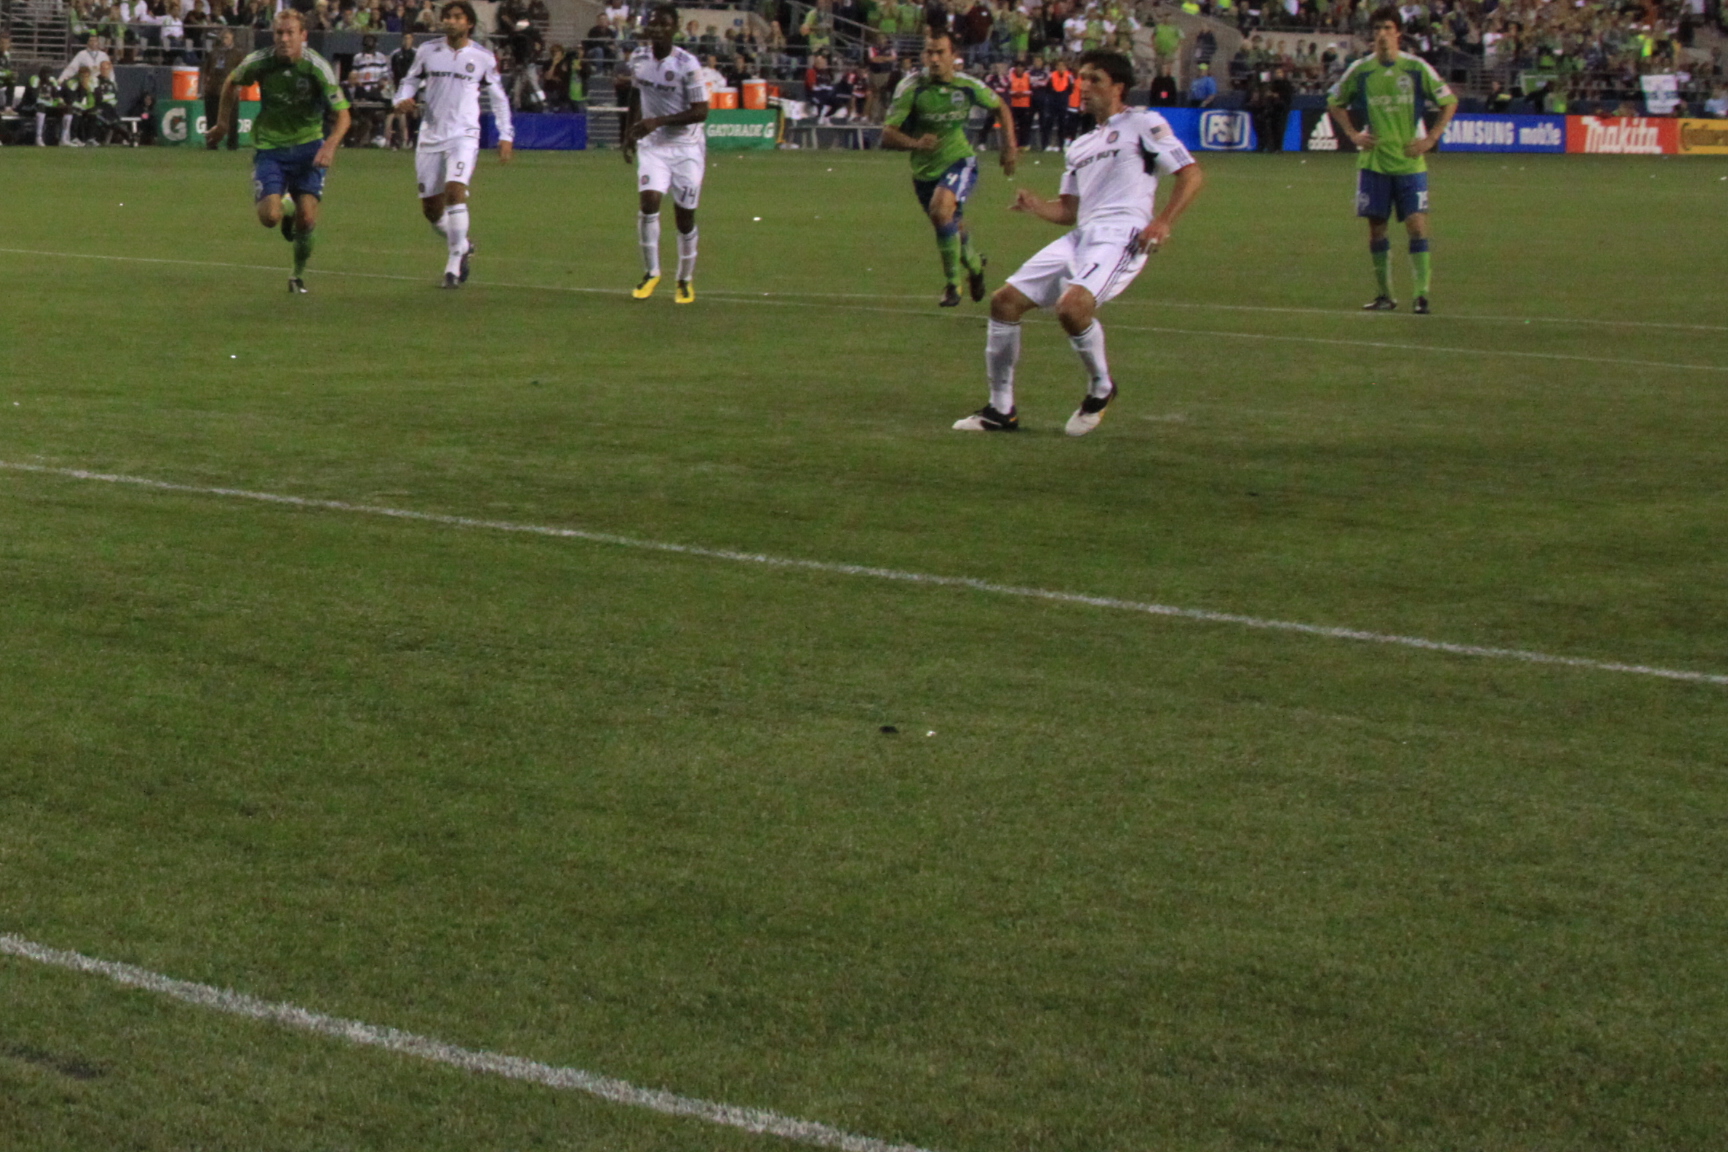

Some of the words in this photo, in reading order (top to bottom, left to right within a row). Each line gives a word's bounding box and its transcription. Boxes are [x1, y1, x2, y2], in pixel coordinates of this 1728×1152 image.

[707, 123, 762, 137] GATORADE
[1442, 120, 1514, 146] SAMSUNG
[454, 161, 465, 177] 9
[946, 172, 959, 186] 4
